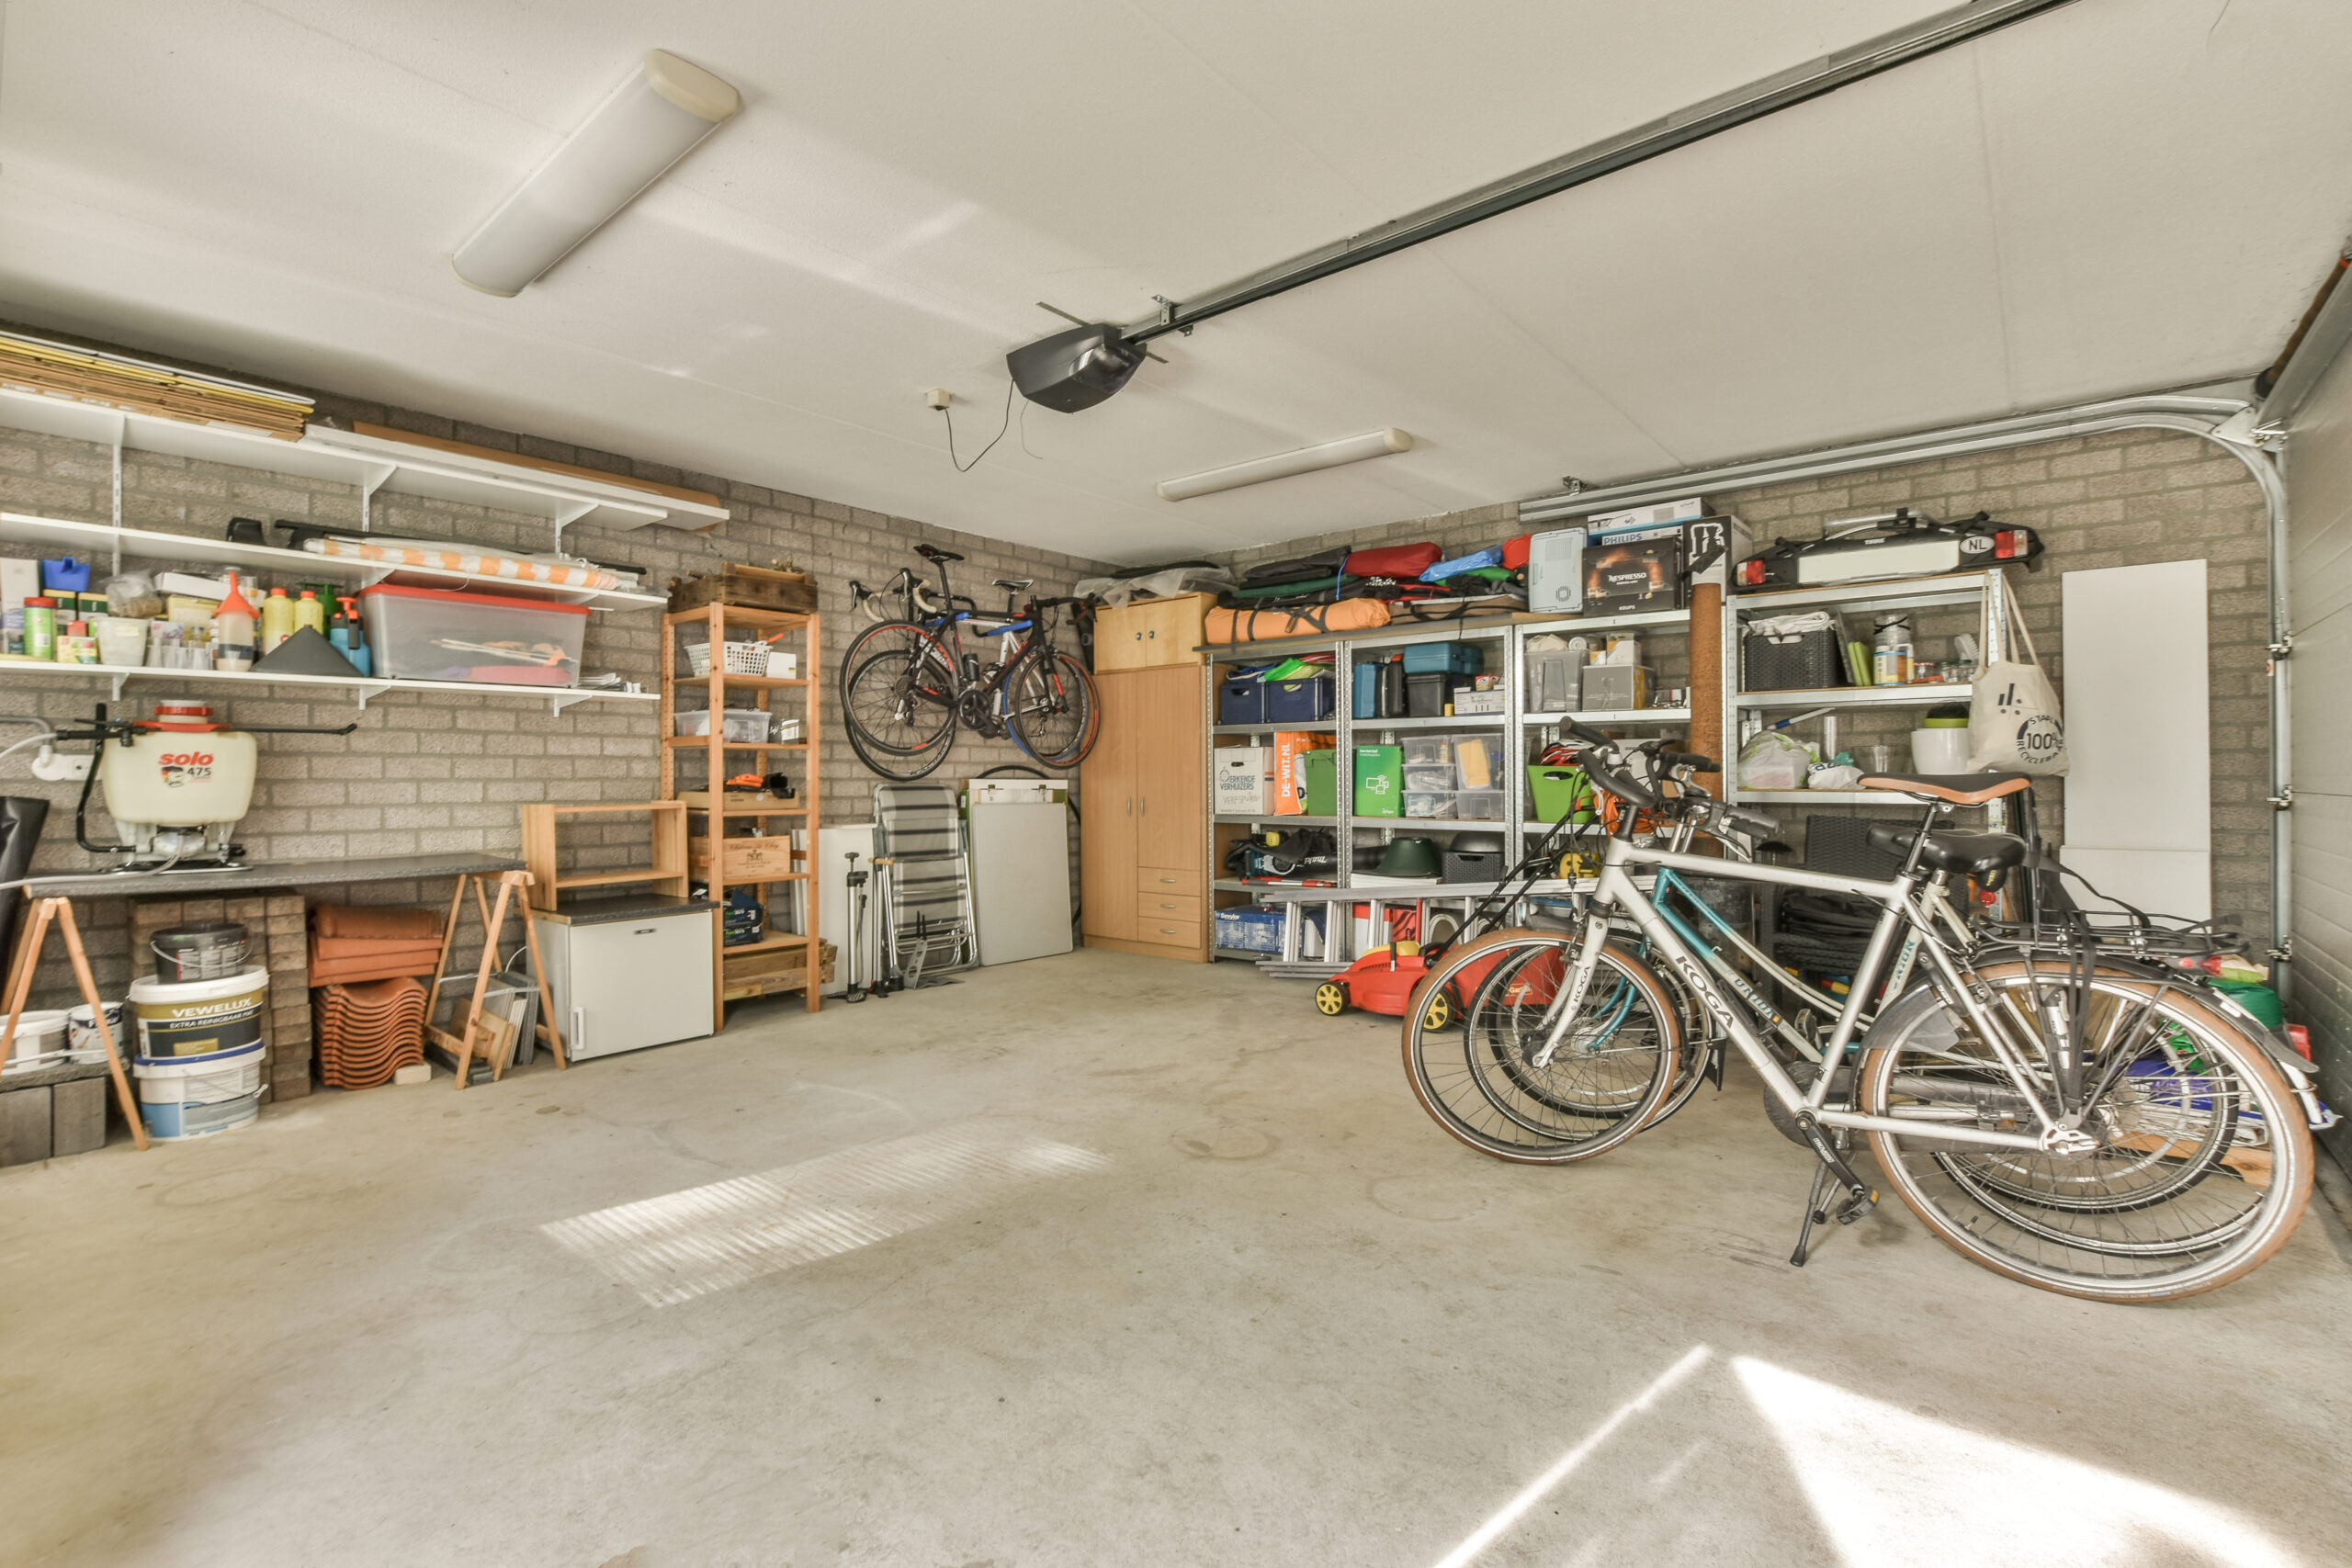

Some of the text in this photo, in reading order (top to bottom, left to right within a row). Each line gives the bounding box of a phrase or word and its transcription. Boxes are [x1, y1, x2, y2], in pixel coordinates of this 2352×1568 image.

[1603, 533, 1643, 545] PHILIPS
[1968, 539, 1987, 551] NL
[1608, 571, 1647, 582] NESPRESSO
[158, 750, 214, 766] solo
[187, 767, 212, 776] 475
[1281, 742, 1292, 798] DE-WIT.NL
[1219, 783, 1255, 791] VERHUIZERS
[1574, 965, 1591, 1005] KOGA
[1674, 955, 1735, 1030] KOGA
[171, 998, 253, 1018] VEWELUX
[169, 1021, 197, 1030] EXTRA
